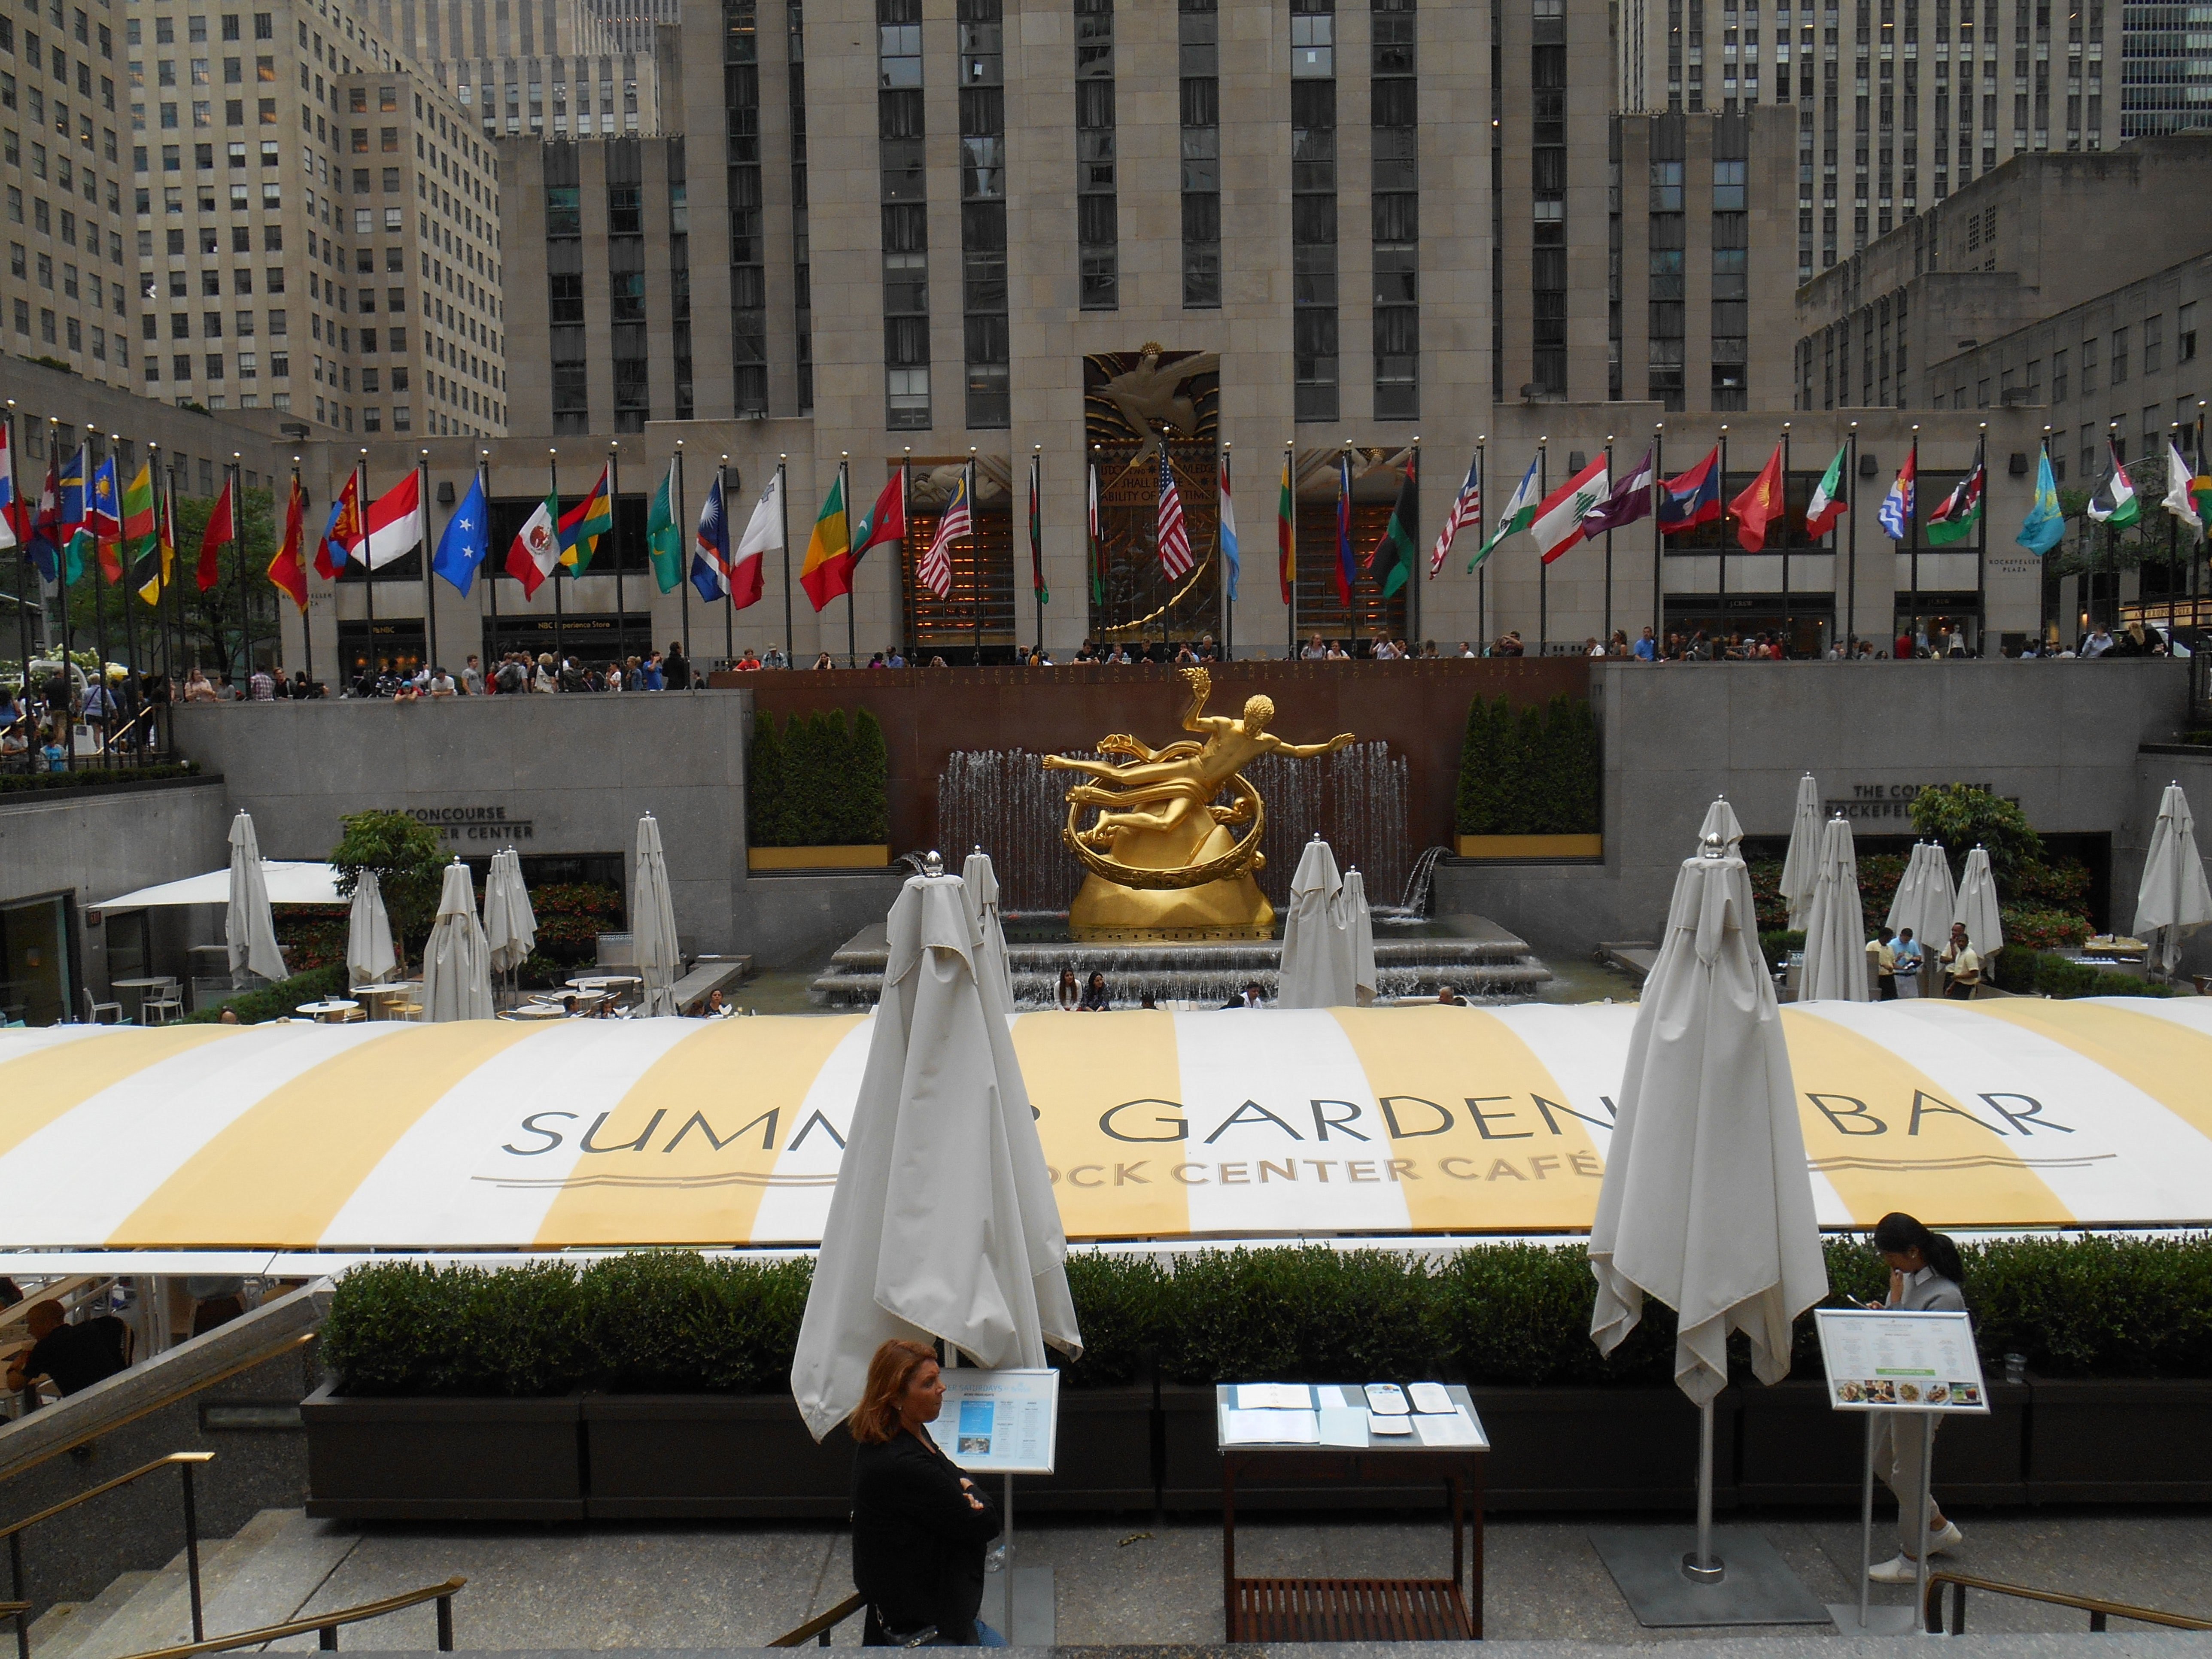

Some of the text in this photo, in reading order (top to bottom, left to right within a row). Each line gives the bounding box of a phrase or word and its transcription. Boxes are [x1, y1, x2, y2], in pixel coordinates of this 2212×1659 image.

[1121, 478, 1151, 488] SHALL
[1100, 490, 1139, 501] ABILITY
[1141, 491, 1156, 501] OF
[554, 622, 591, 630] Eperience
[1854, 785, 1884, 797] THE
[467, 826, 532, 839] CENTER
[1099, 1093, 1617, 1144] GARDEN
[1805, 1089, 2076, 1136] BAR
[1170, 1158, 1422, 1186] CENTER
[1438, 1150, 1604, 1182] CAFÉ
